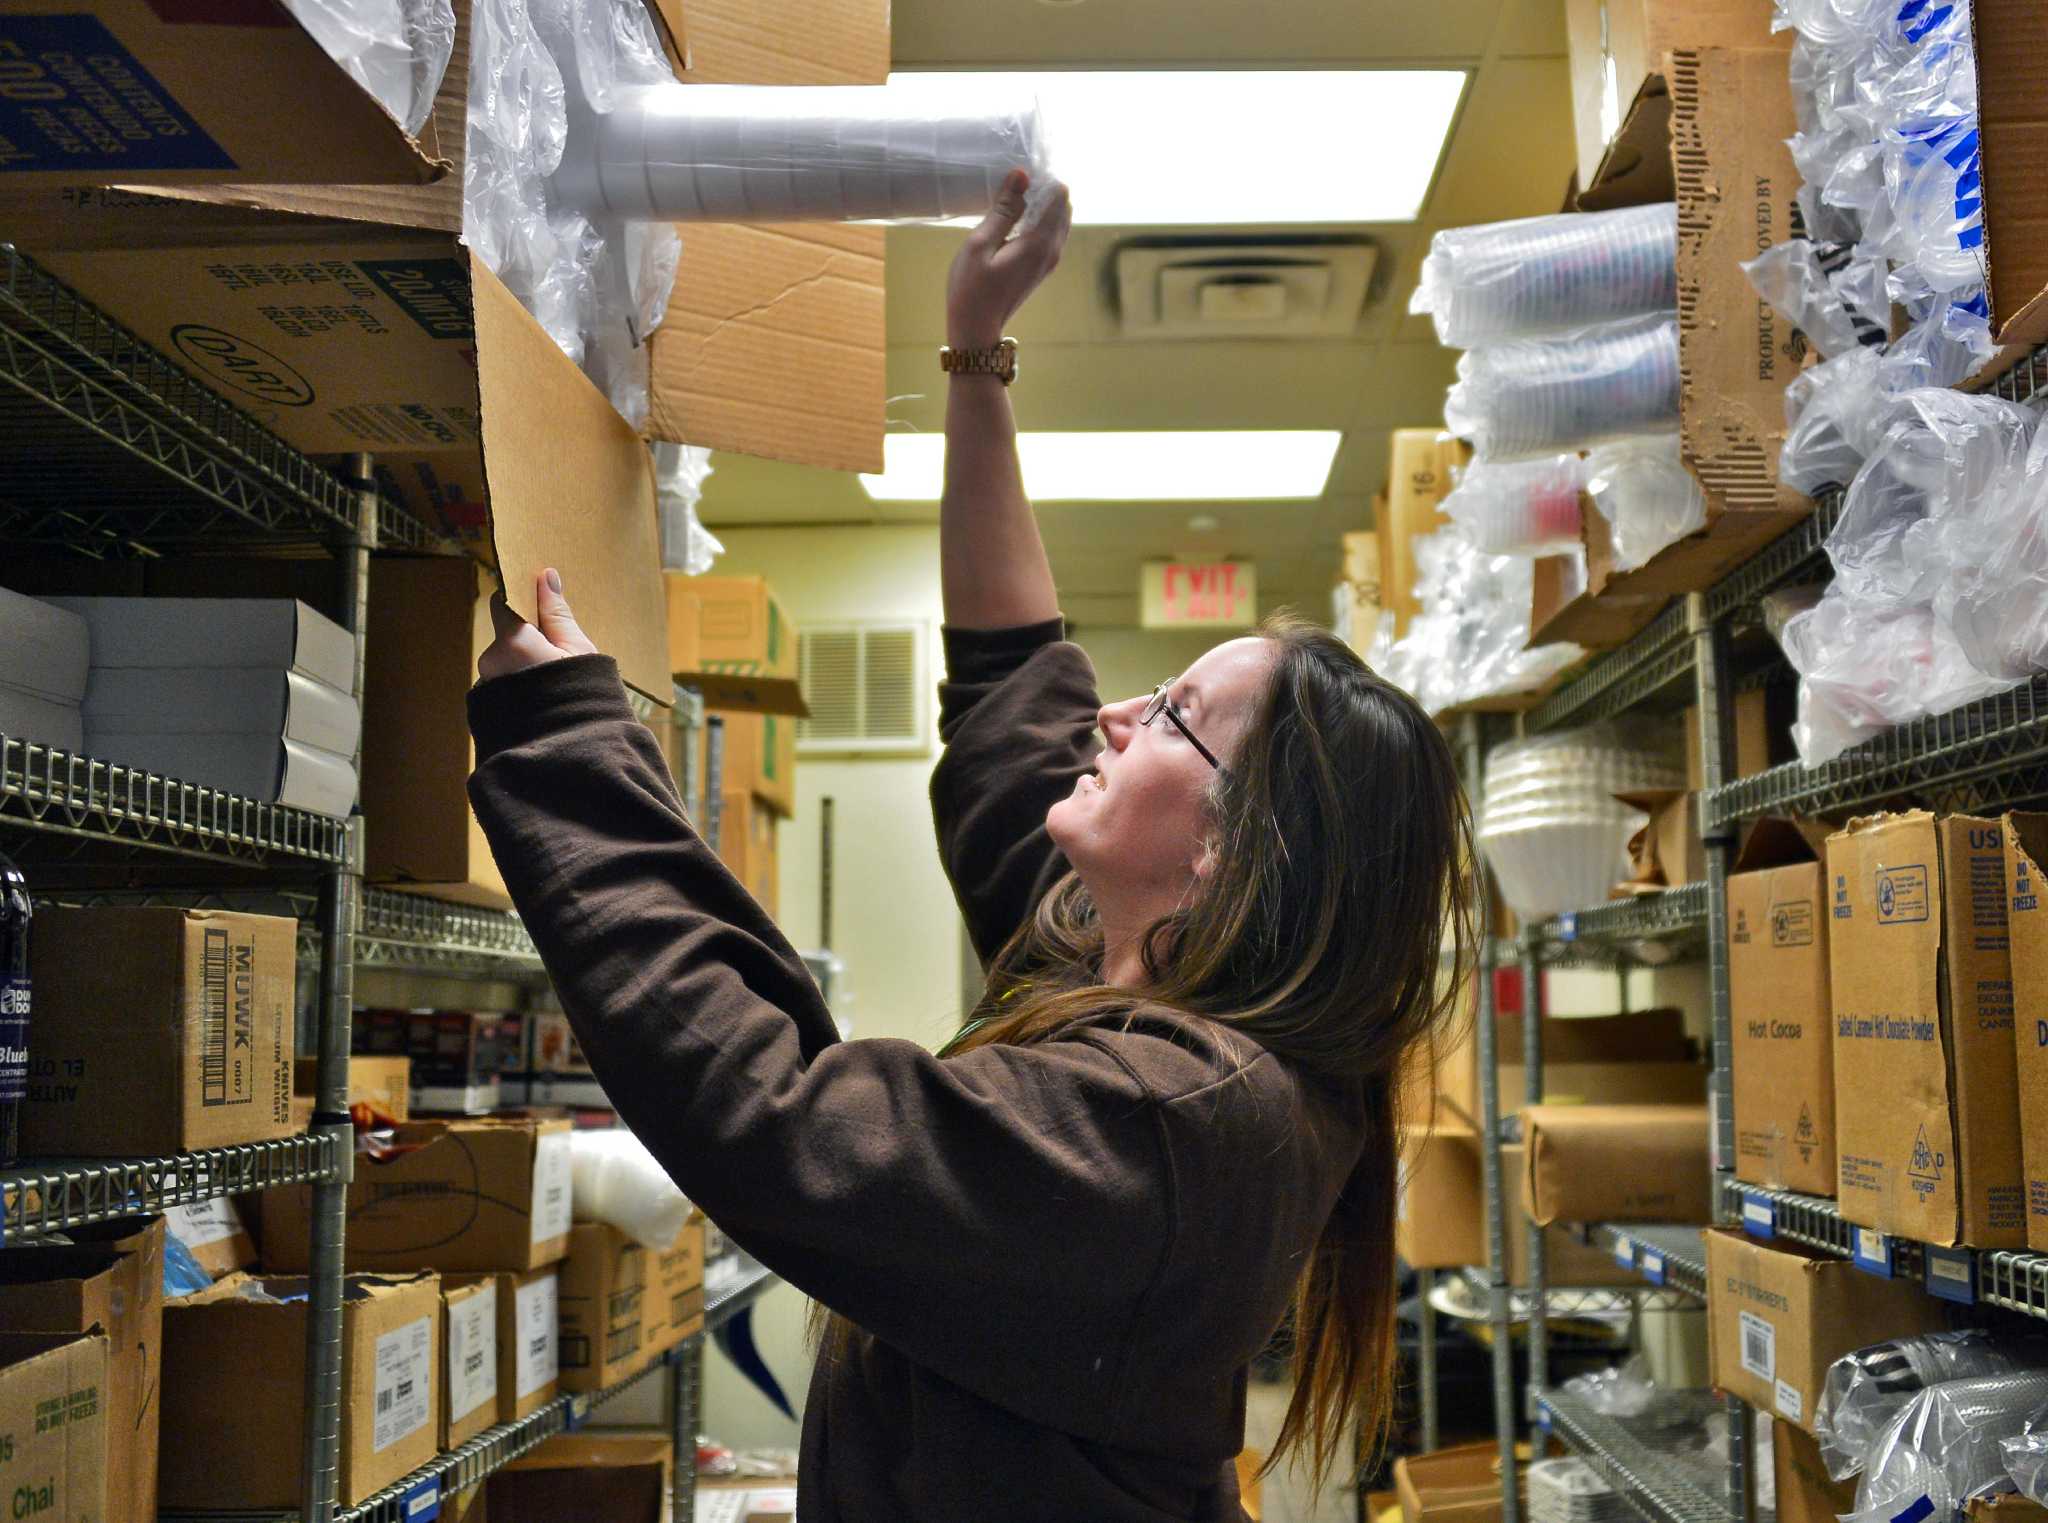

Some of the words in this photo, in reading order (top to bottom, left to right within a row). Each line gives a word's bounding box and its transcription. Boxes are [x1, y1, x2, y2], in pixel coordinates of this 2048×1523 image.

[1756, 176, 1771, 197] BY
[1759, 298, 1775, 381] PRODUCT
[183, 335, 303, 397] DART
[1163, 563, 1238, 620] EXIT
[1969, 829, 2004, 849] US
[2012, 895, 2038, 912] FREEZE
[2015, 879, 2030, 893] NOT
[234, 944, 251, 1049] MUWK
[1748, 1020, 1767, 1038] Hot
[1770, 1019, 1802, 1039] Cocoa
[1911, 1015, 1935, 1040] Powder
[234, 1060, 242, 1095] 0007
[281, 1060, 289, 1124] KNIVES
[273, 1069, 281, 1124] WEIGHT
[69, 1400, 97, 1422] FREEZE
[13, 1476, 54, 1520] Chai
